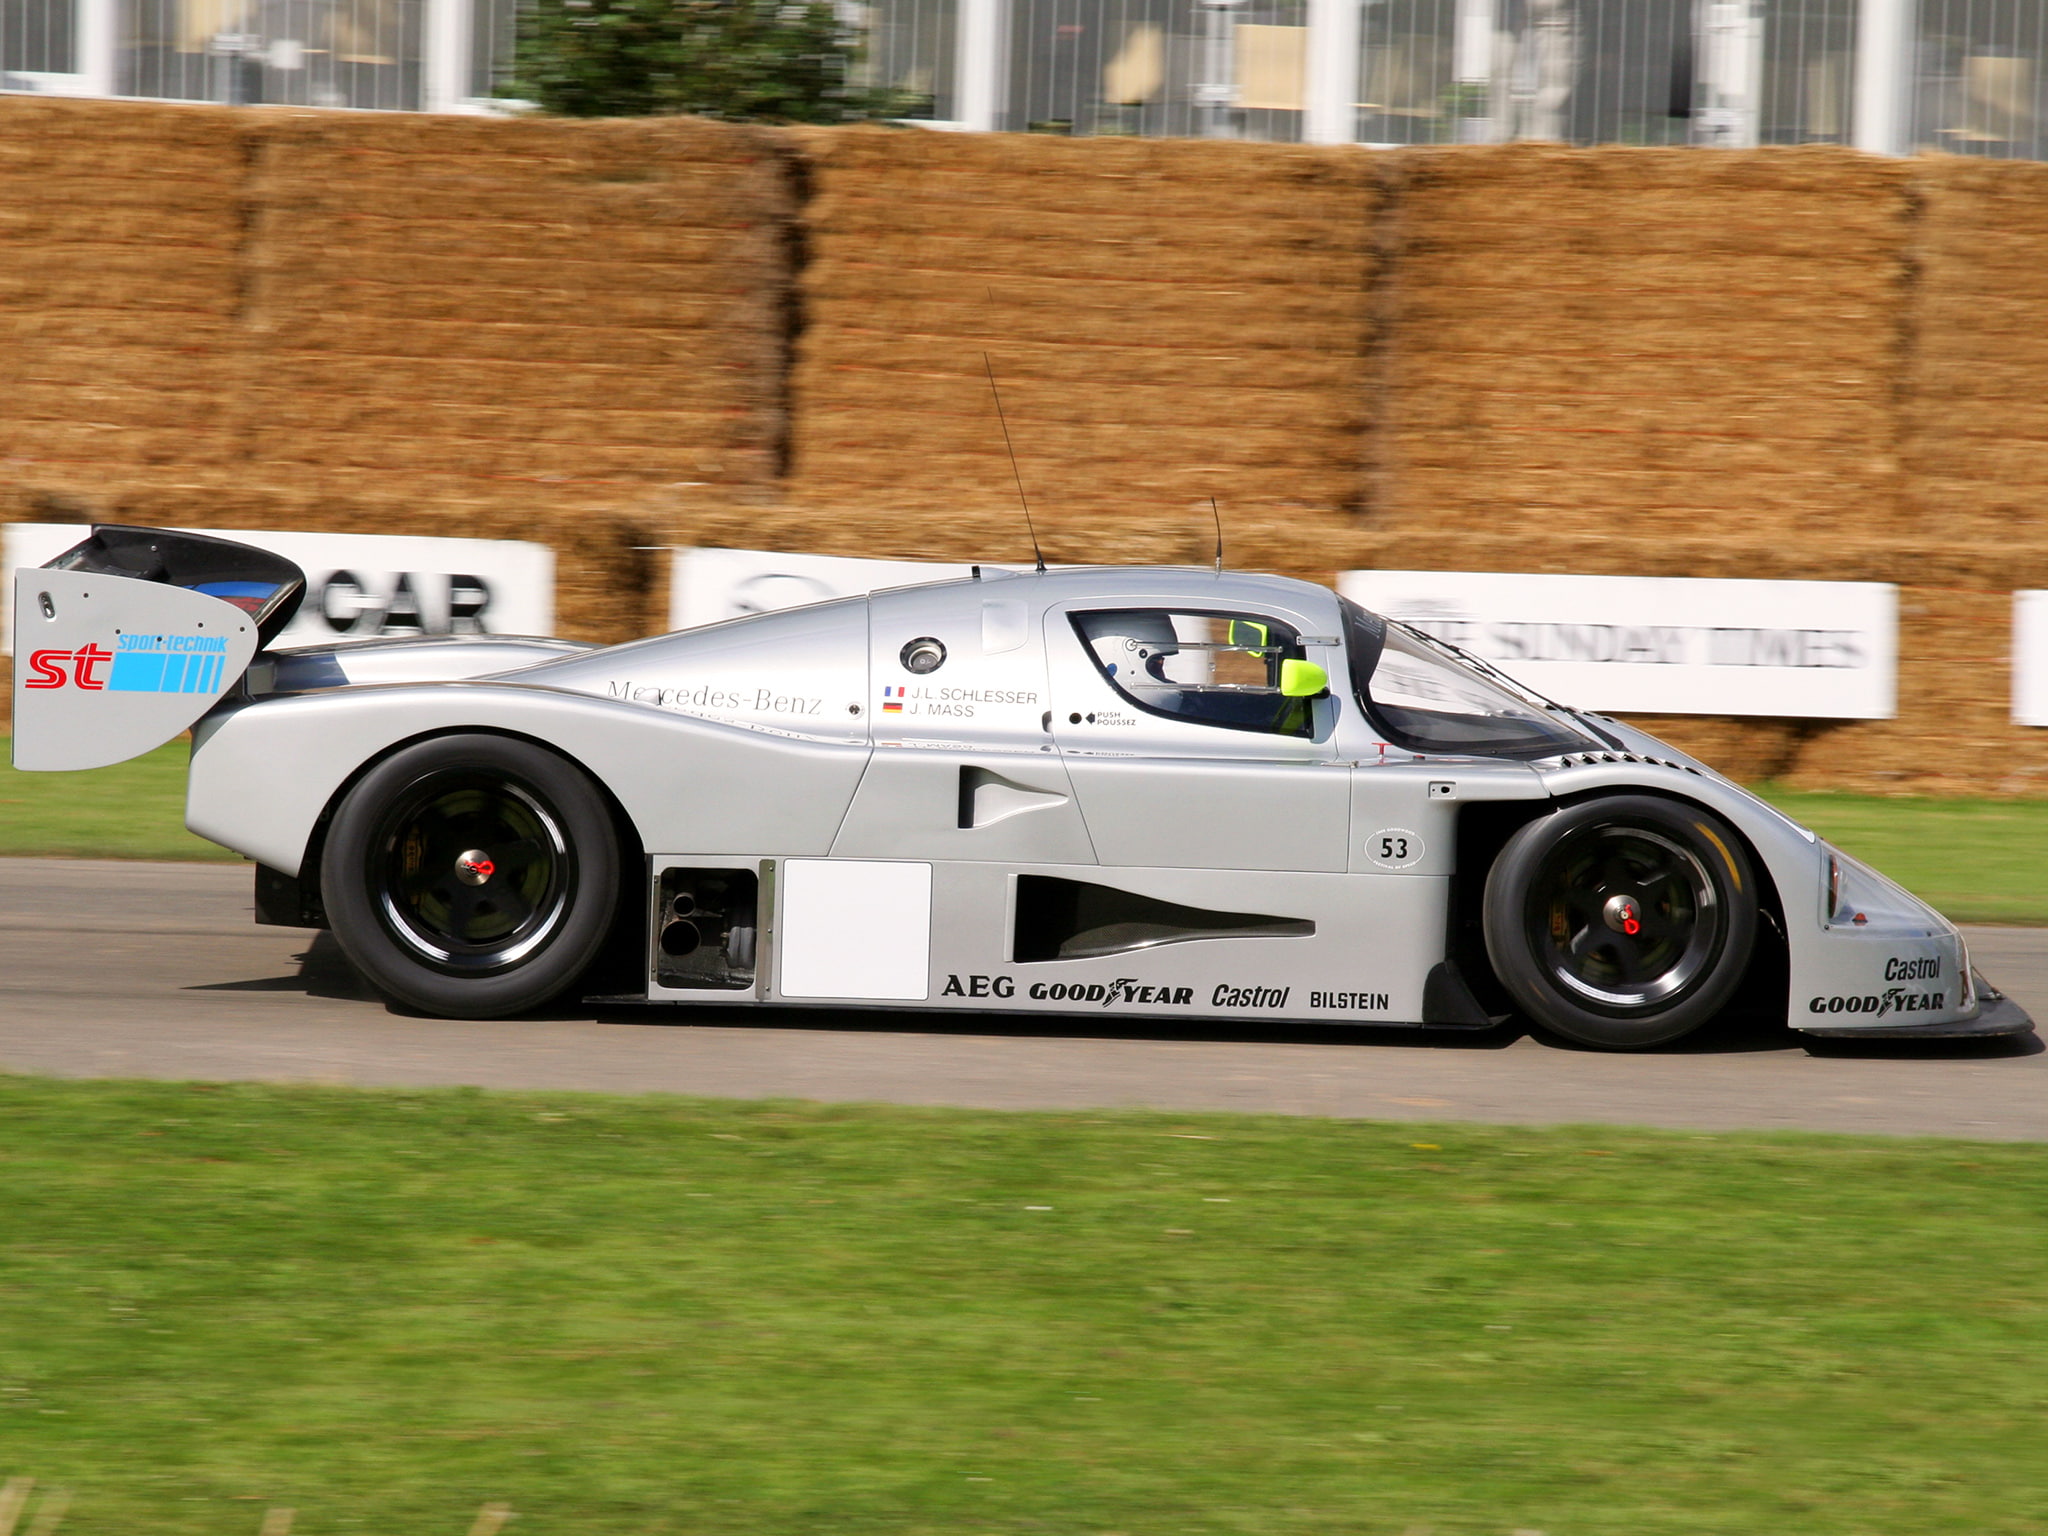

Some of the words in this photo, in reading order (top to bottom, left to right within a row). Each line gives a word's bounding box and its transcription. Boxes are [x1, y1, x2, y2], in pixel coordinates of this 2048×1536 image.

[607, 680, 822, 716] Mecedes-Benz
[927, 703, 975, 718] MASS
[1380, 837, 1408, 859] 53
[1884, 956, 1941, 982] Castrol
[941, 973, 1016, 999] AEG
[1210, 983, 1291, 1009] Castrol
[1310, 990, 1390, 1011] BILSTEIN
